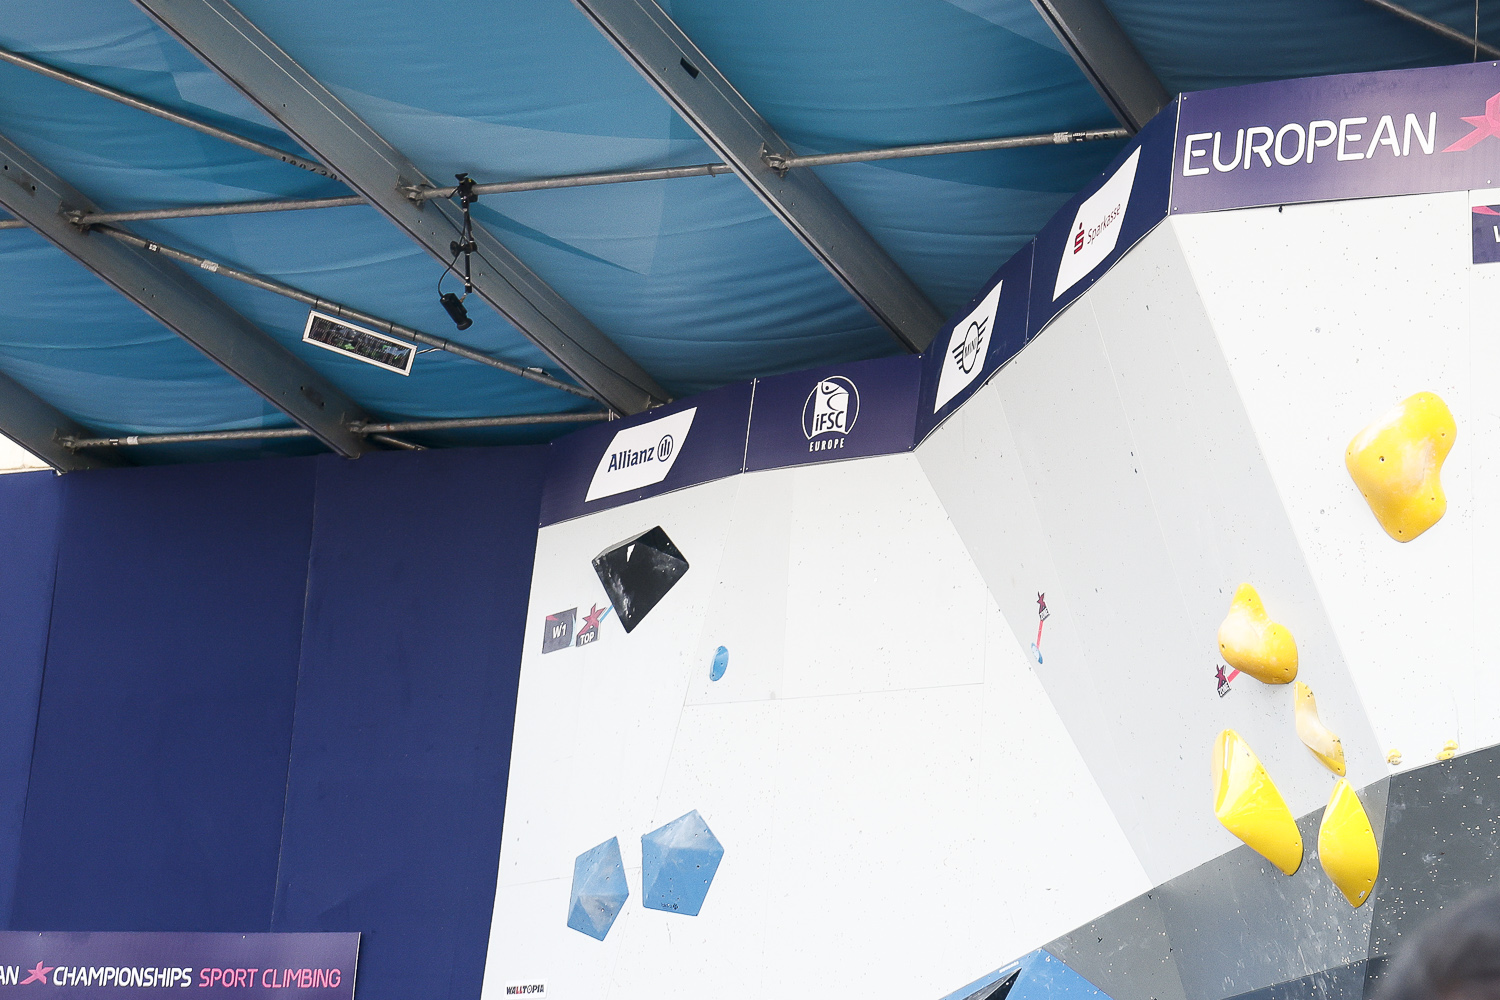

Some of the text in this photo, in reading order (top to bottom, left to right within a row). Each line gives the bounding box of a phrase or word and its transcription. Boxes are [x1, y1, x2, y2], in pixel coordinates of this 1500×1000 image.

[1183, 112, 1437, 177] EUROPEAN
[1087, 203, 1121, 245] Sparkasse
[809, 437, 845, 453] EUROPE
[607, 446, 655, 473] Allianz
[552, 623, 567, 639] W1
[580, 631, 595, 646] TOP
[53, 966, 193, 988] CHAMPIONSHIPS
[199, 967, 258, 988] SPORT
[262, 968, 341, 988] CLIMBING
[506, 984, 544, 995] WALLTOPIA
